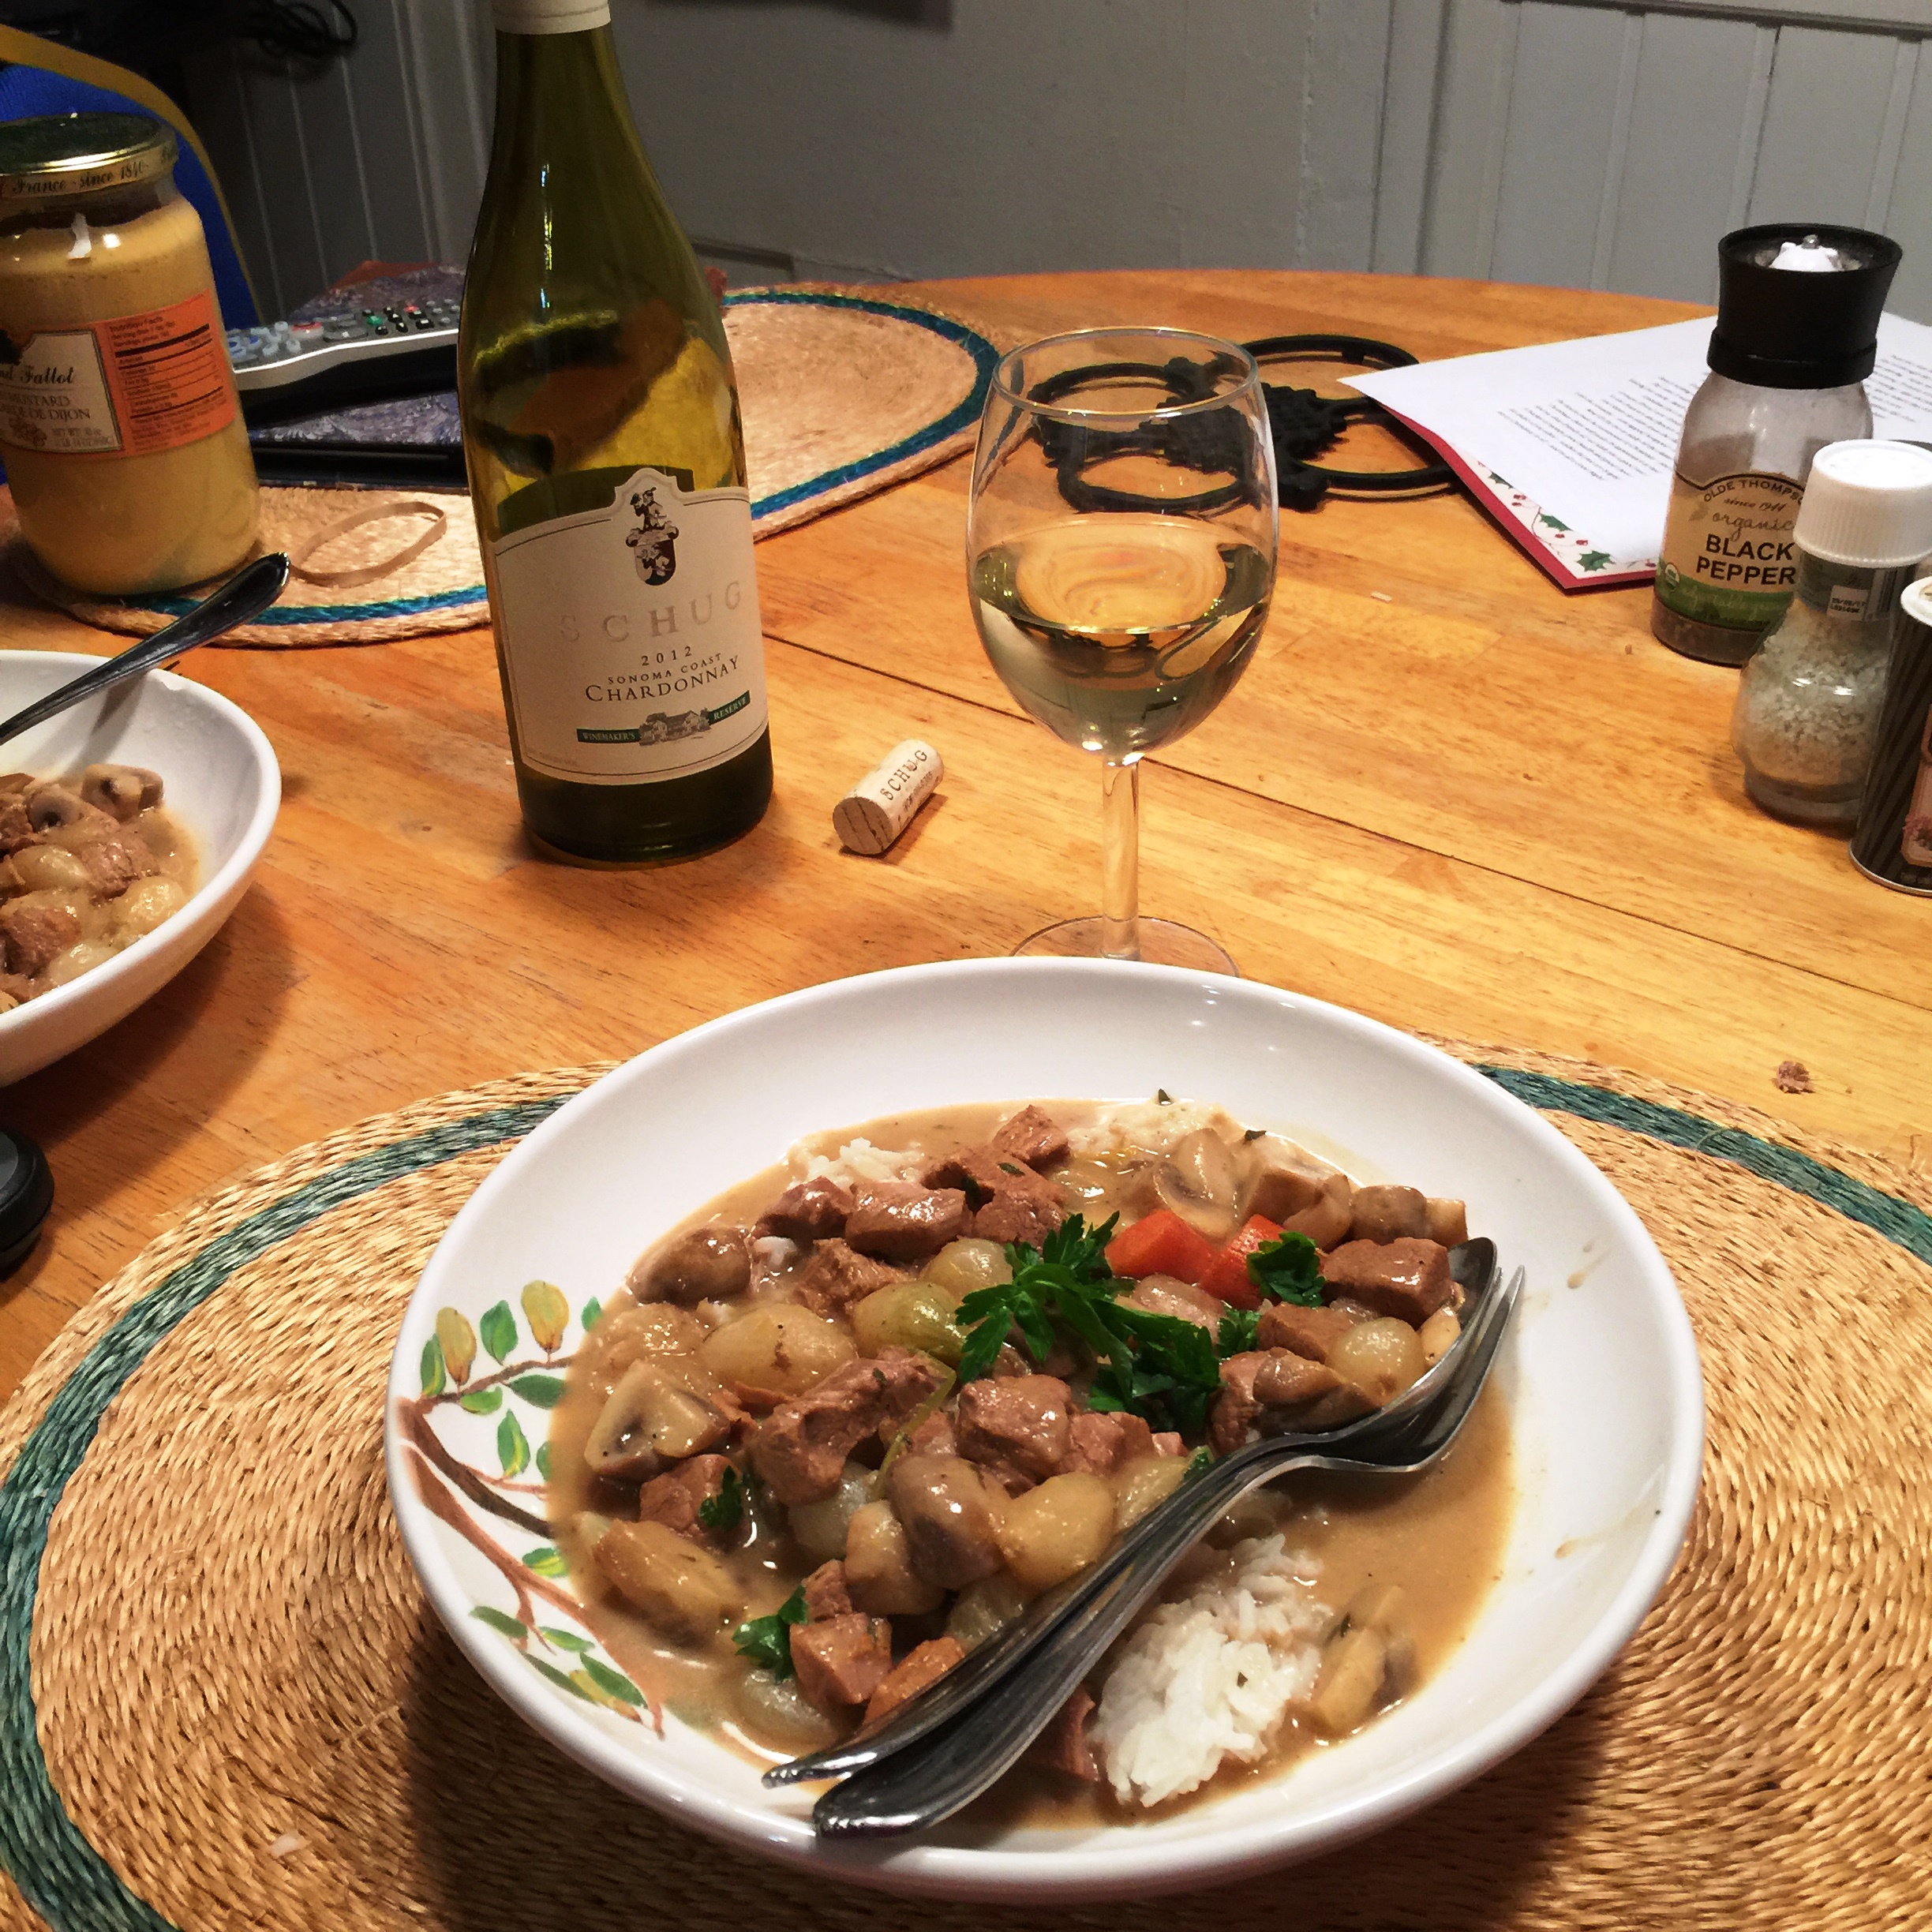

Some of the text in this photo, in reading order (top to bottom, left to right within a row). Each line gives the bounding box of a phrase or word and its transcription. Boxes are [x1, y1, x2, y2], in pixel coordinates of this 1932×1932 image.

[80, 170, 114, 188] since
[1704, 481, 1735, 503] OLDE
[1724, 497, 1756, 508] since
[1712, 512, 1795, 541] organic
[1705, 533, 1795, 560] BLACK
[1696, 555, 1796, 585] PEPPER
[560, 581, 741, 642] SCHUG
[608, 653, 722, 685] SONOMA COAST
[641, 646, 693, 666] 2012
[585, 655, 739, 702] CHARDONNAY
[713, 697, 747, 721] RESERVE
[880, 750, 927, 800] SCHUG
